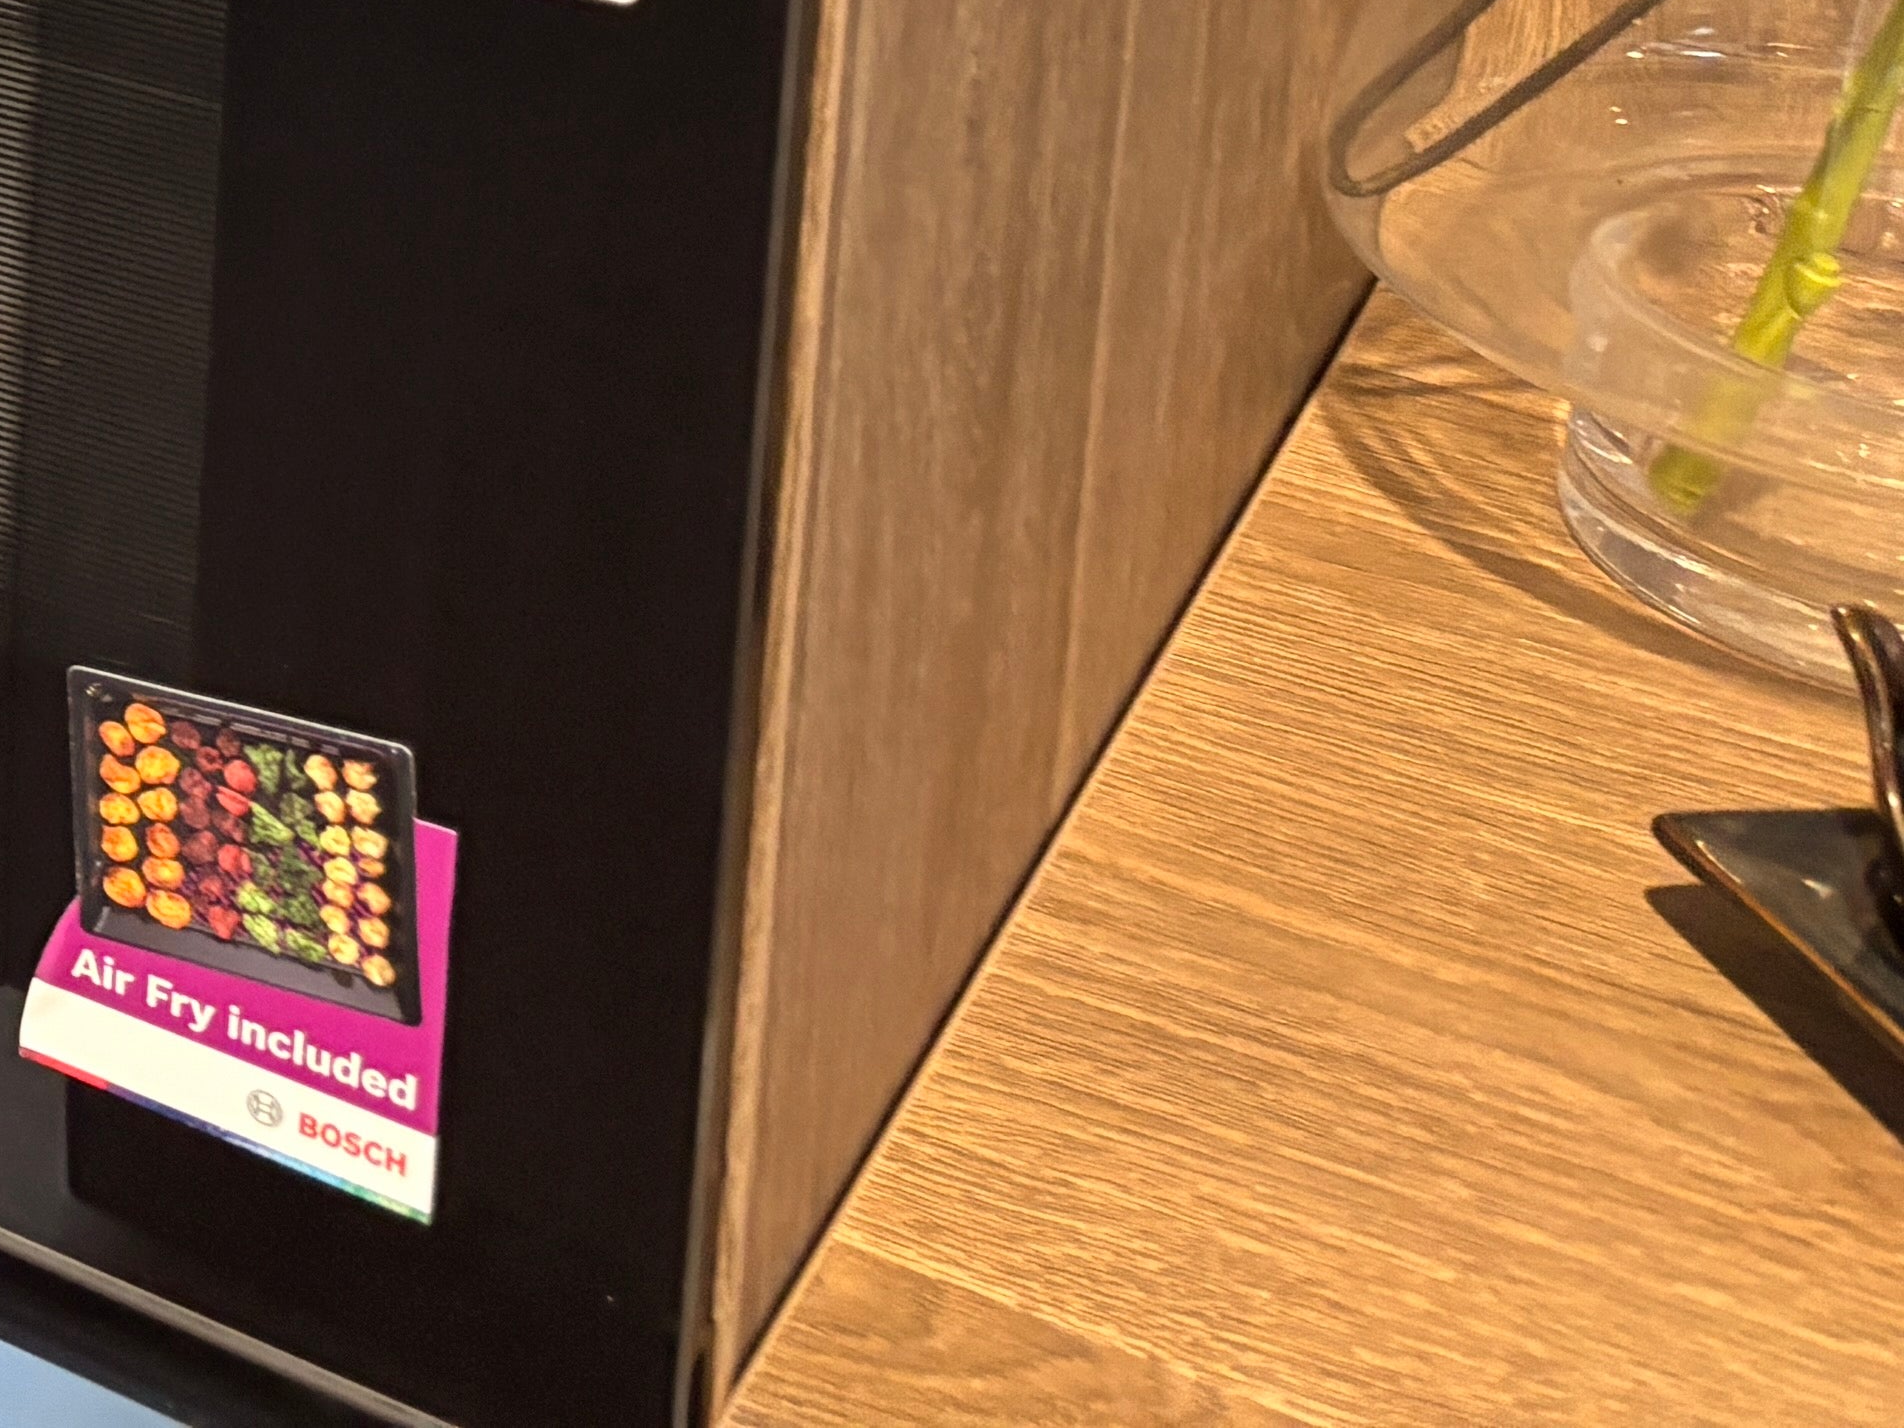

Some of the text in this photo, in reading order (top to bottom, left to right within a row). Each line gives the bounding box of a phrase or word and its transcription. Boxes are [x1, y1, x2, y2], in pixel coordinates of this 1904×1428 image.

[70, 948, 418, 1112] Air Fry included
[297, 1111, 409, 1178] BOSCH
